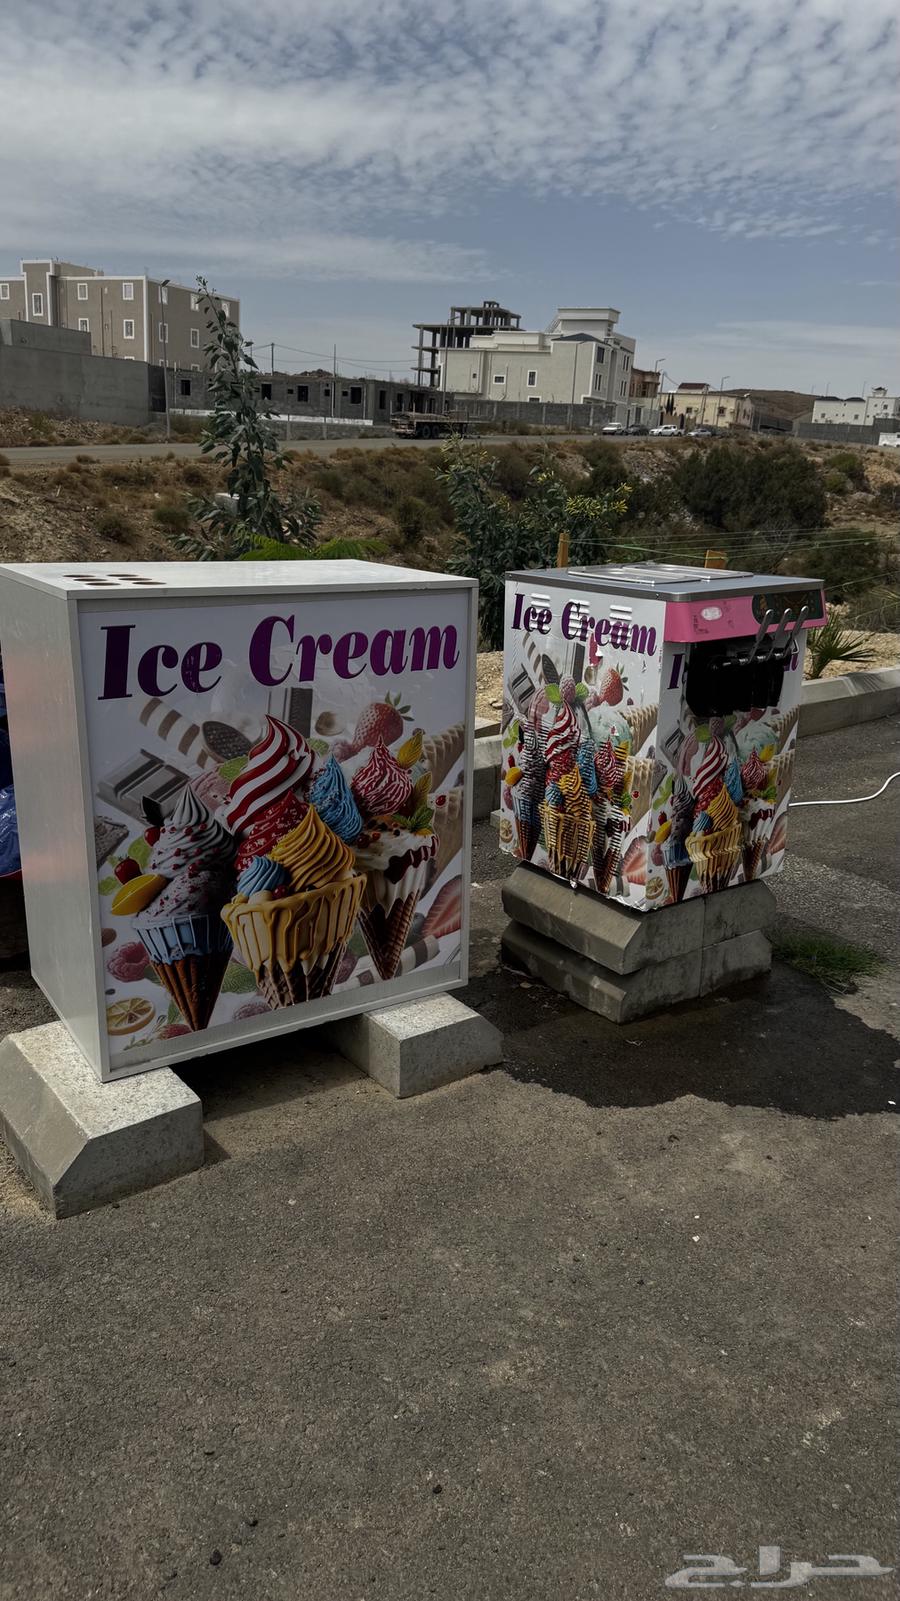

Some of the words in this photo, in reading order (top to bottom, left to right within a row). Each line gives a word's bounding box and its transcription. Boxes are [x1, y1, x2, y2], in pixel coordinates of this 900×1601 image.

[97, 624, 223, 701] Ice
[248, 613, 461, 687] Cream
[511, 593, 552, 635] Ice
[561, 600, 657, 657] Cream
